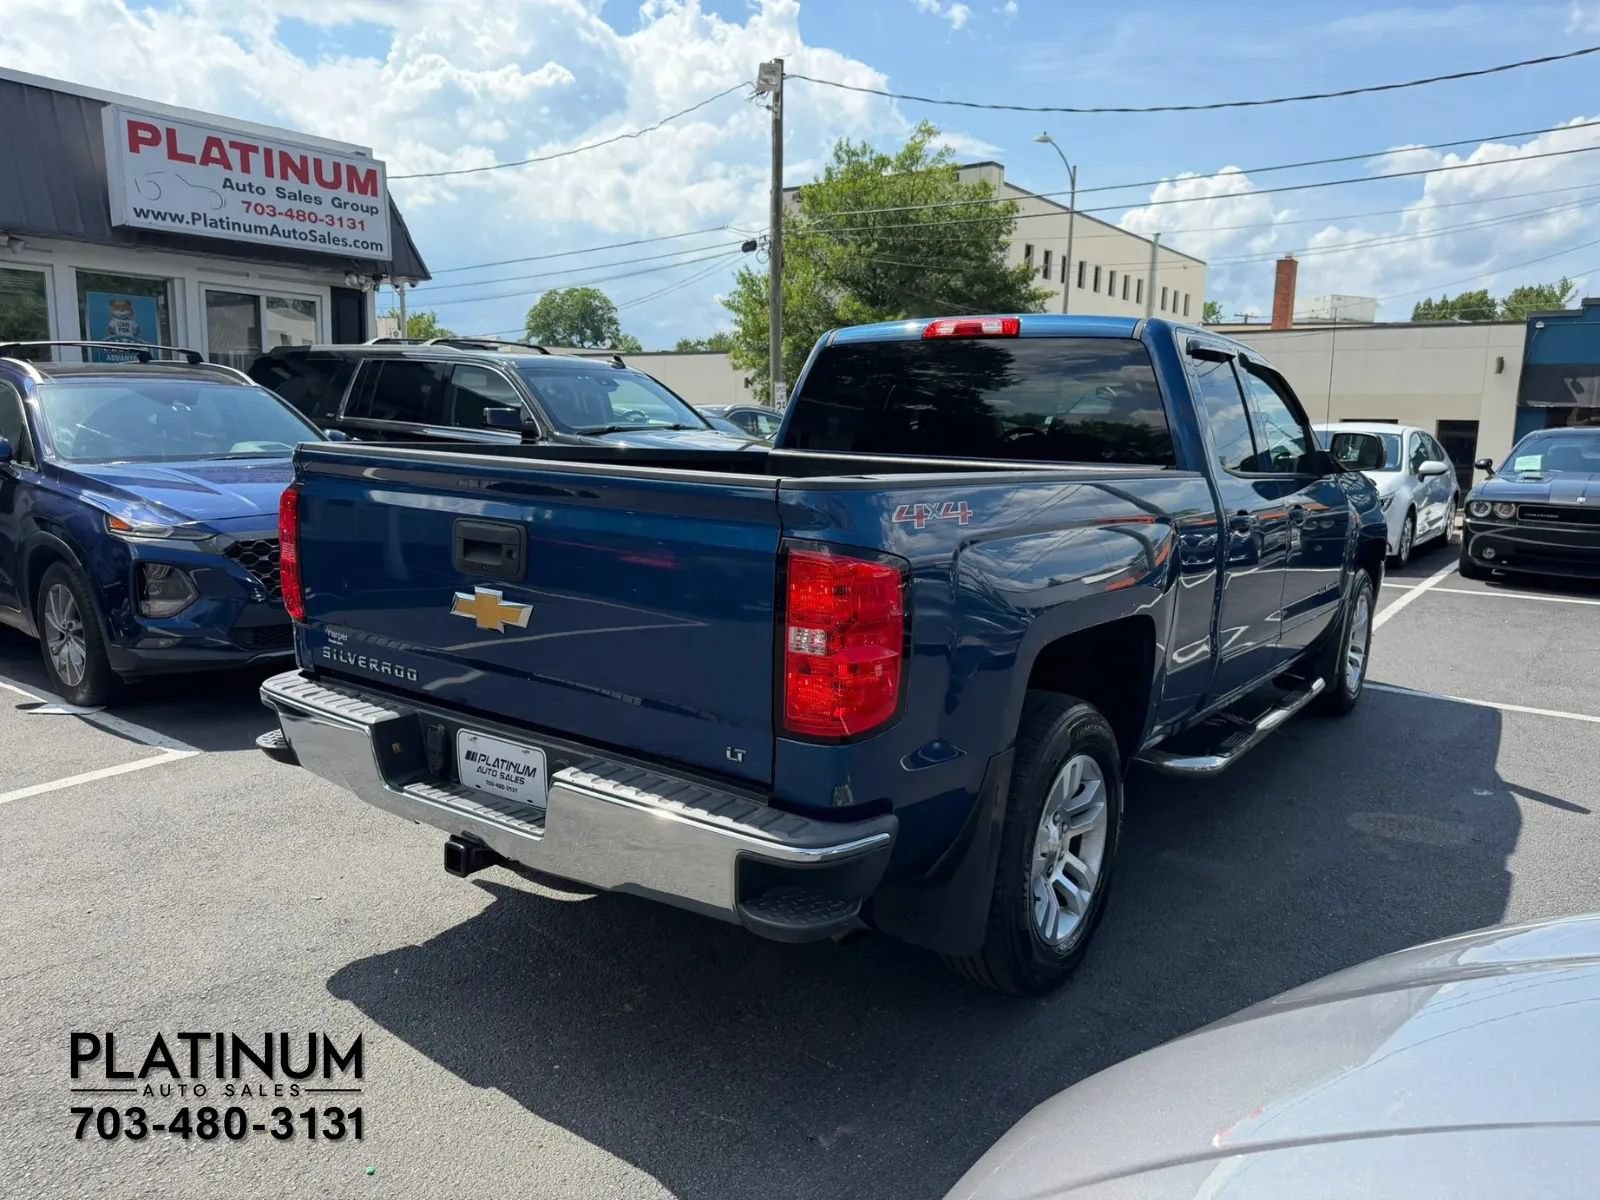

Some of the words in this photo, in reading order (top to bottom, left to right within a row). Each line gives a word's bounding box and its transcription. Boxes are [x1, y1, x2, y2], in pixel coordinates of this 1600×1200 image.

[127, 119, 379, 198] PLATINUM
[222, 177, 266, 196] Auto
[275, 186, 323, 206] Sales
[331, 196, 379, 216] Group
[132, 206, 384, 252] www.PlatinumAutoSales.com
[241, 200, 365, 231] 703-480-3131
[106, 353, 139, 362] ADVANTA
[322, 646, 417, 681] SILVERADO
[477, 753, 537, 779] PLATINUM
[726, 746, 747, 763] LT
[476, 765, 498, 778] AUTO
[500, 771, 525, 785] SALES
